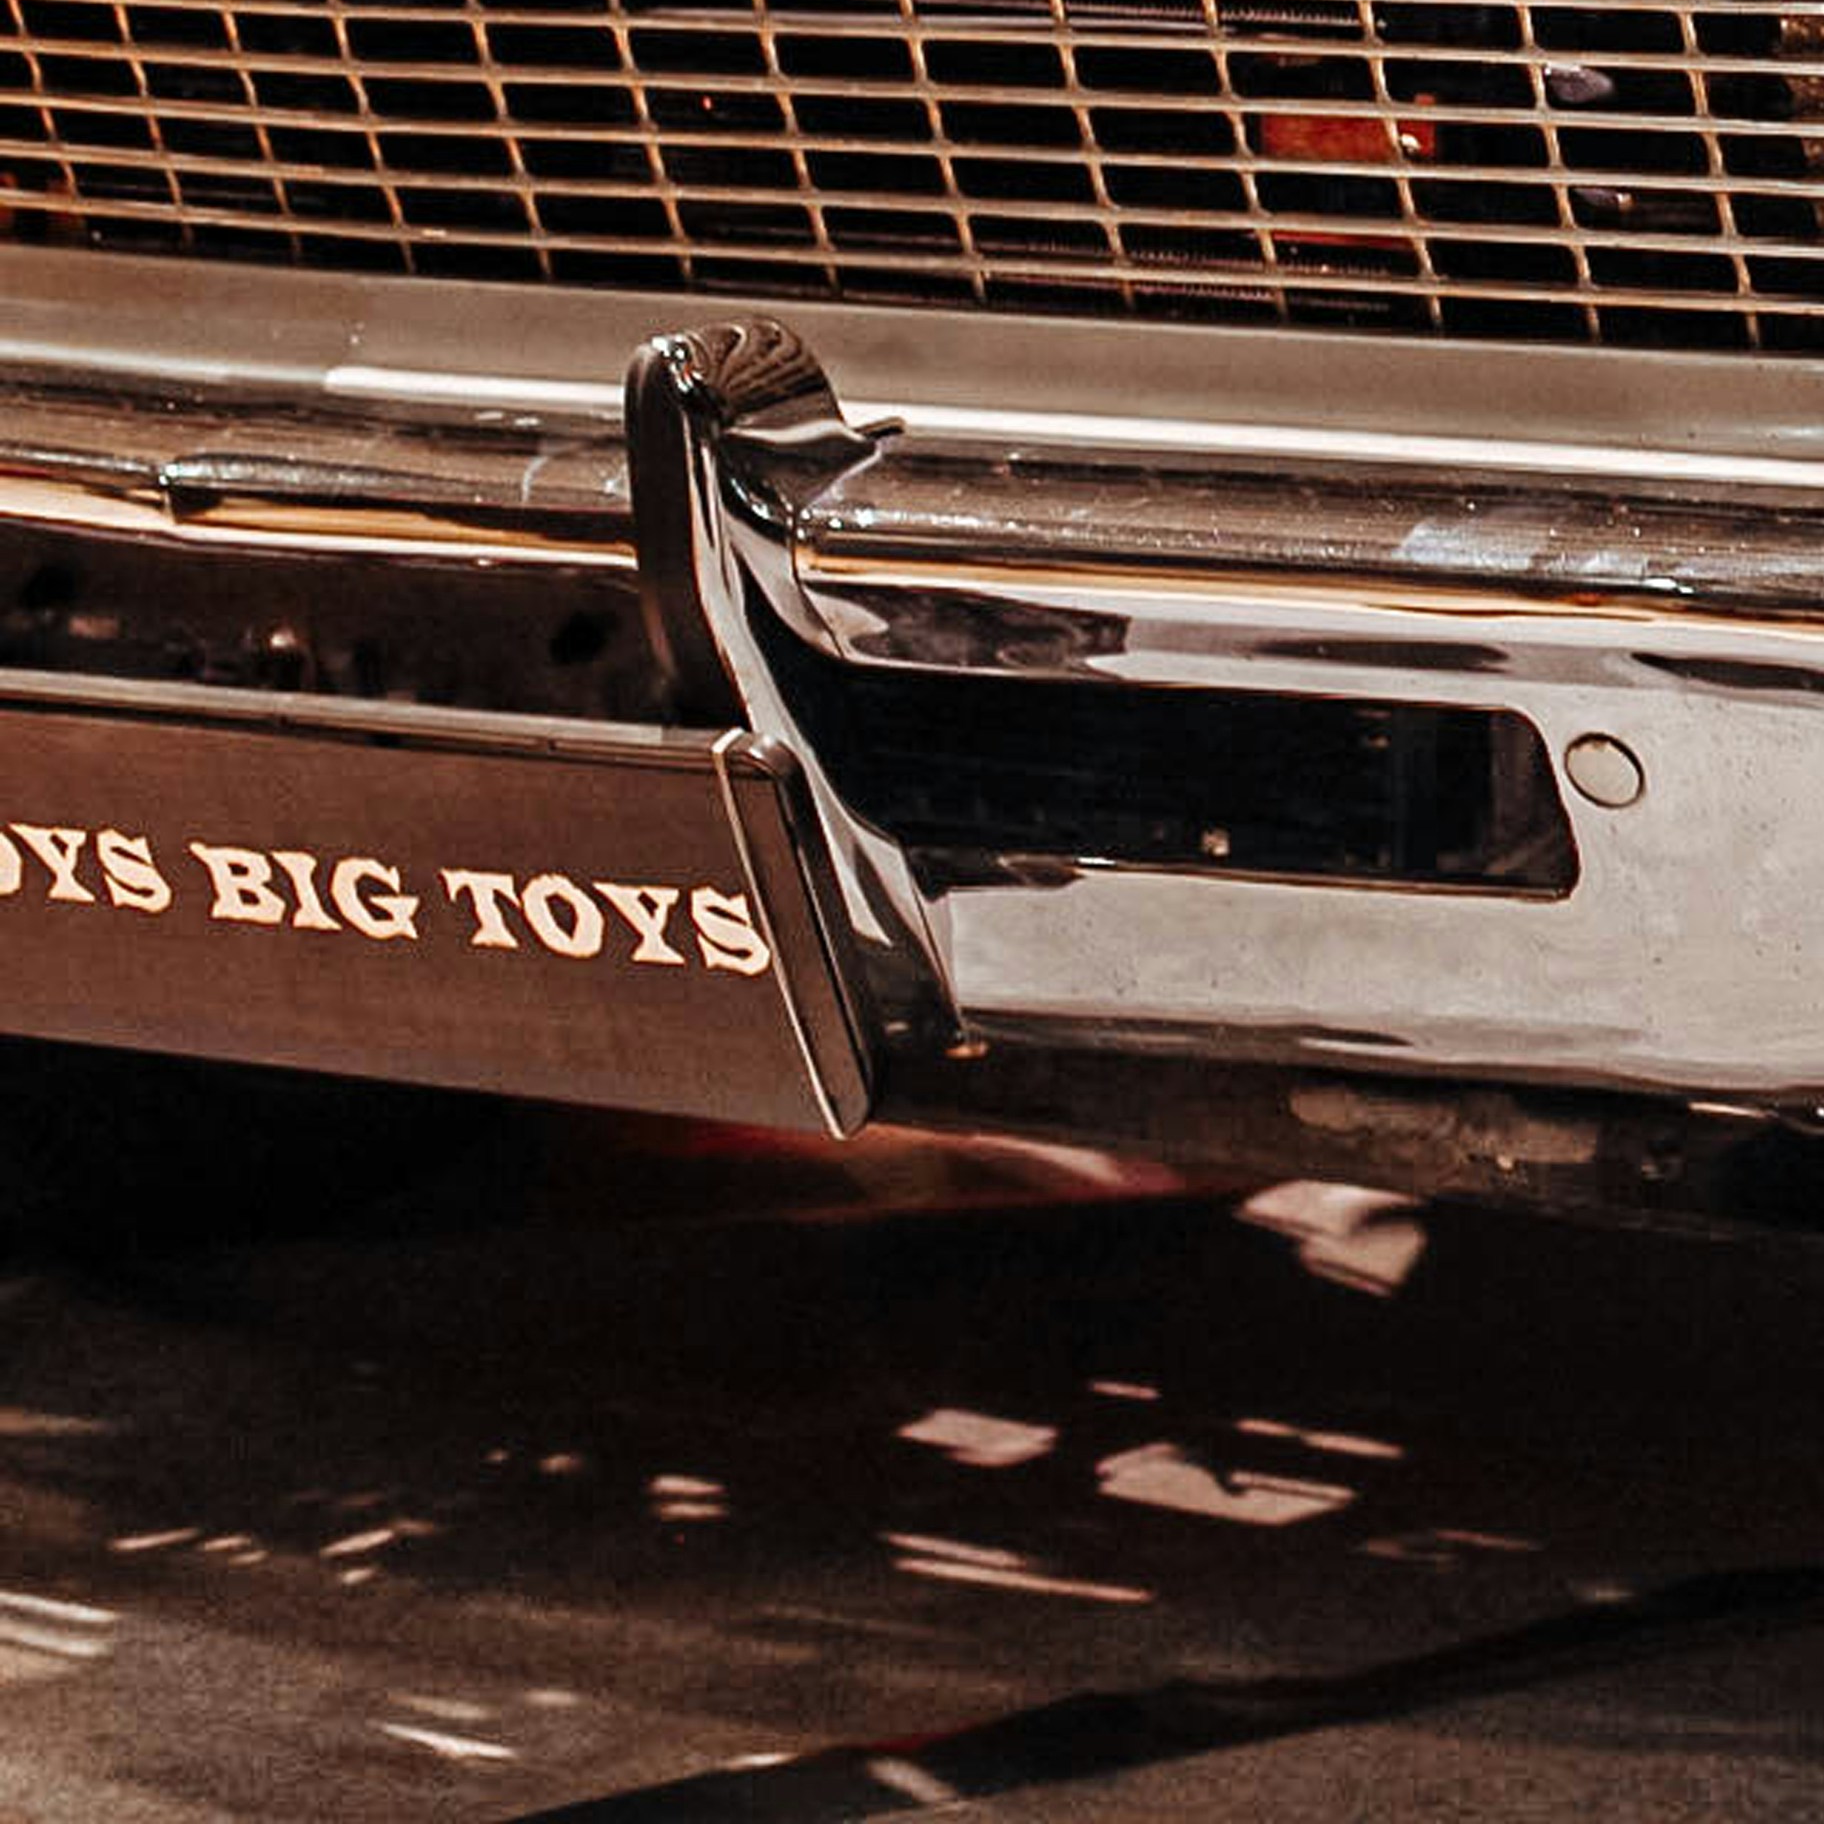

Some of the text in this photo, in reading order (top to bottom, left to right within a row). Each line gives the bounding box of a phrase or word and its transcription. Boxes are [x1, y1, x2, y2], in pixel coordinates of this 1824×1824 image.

[0, 824, 772, 976] YS BIG TOYS
